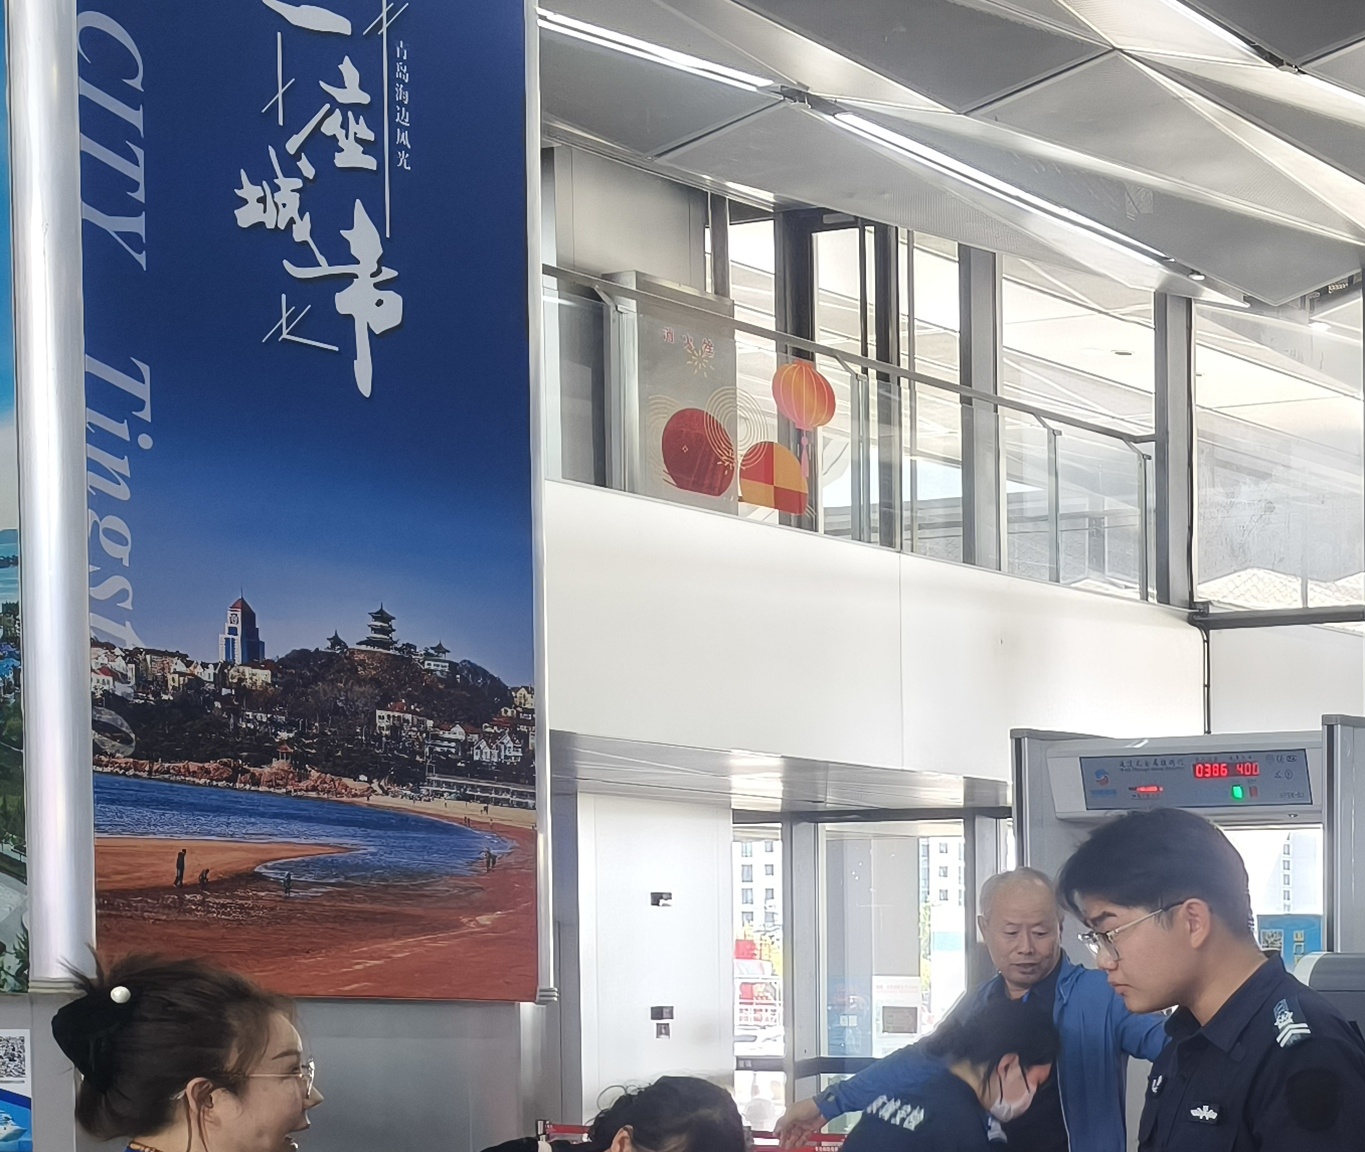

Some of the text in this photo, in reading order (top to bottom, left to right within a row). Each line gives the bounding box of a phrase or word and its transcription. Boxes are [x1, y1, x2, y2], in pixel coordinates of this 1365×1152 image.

[77, 10, 146, 271] CITY
[1195, 763, 1228, 778] 0386
[1236, 762, 1260, 776] 400
